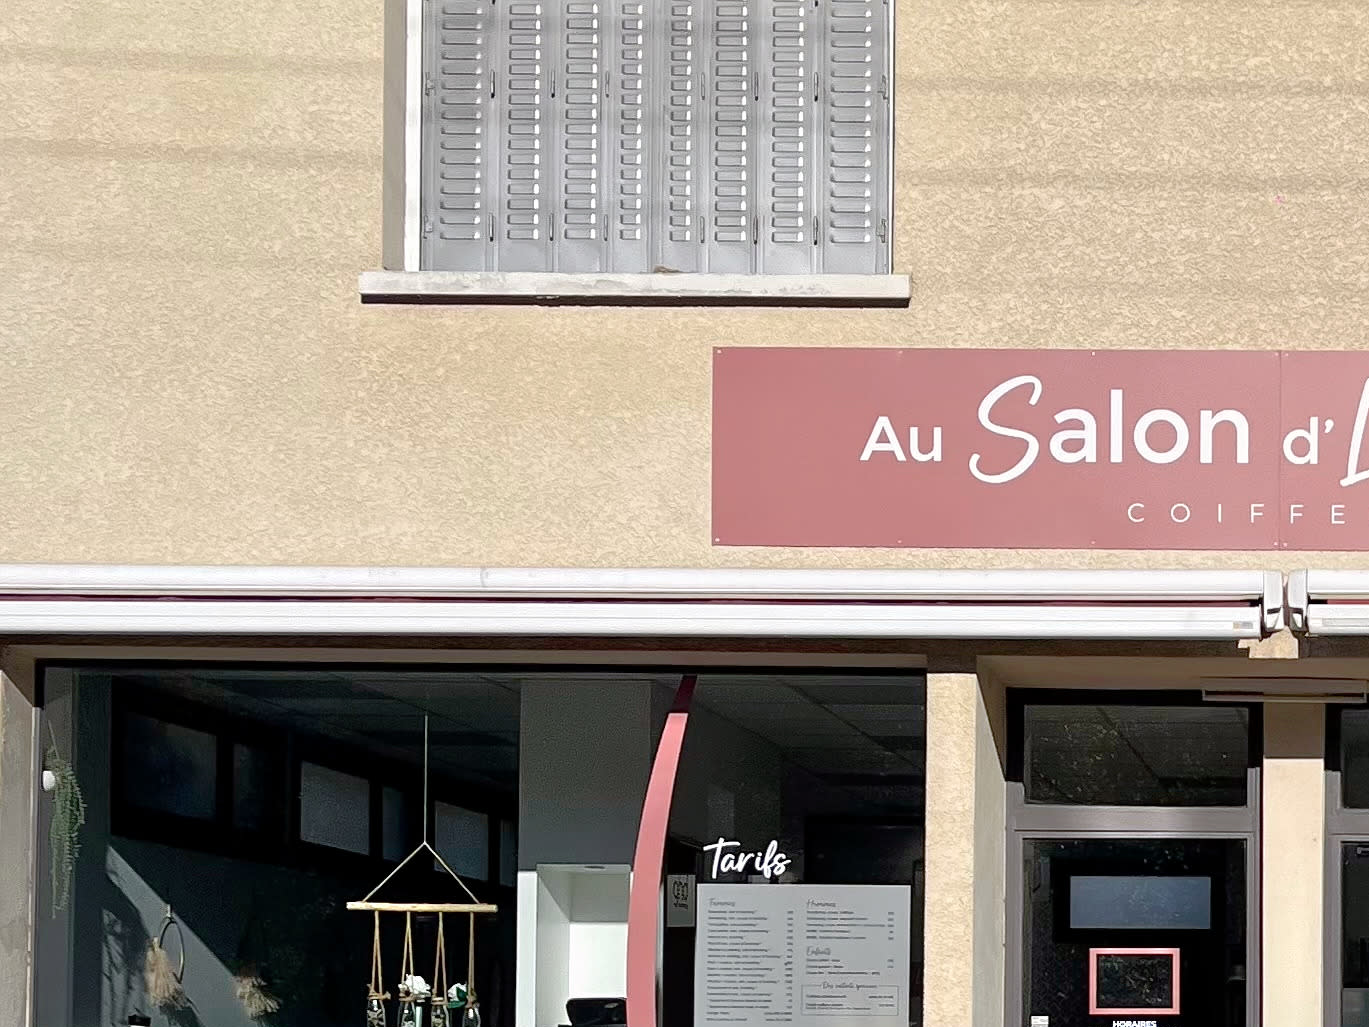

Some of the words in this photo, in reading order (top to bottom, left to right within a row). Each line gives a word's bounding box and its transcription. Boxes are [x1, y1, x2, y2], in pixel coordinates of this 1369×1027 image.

[861, 416, 942, 462] Au
[968, 375, 1250, 484] Salon
[703, 837, 792, 879] Tarifs
[1112, 1020, 1157, 1027] HORAIRES
